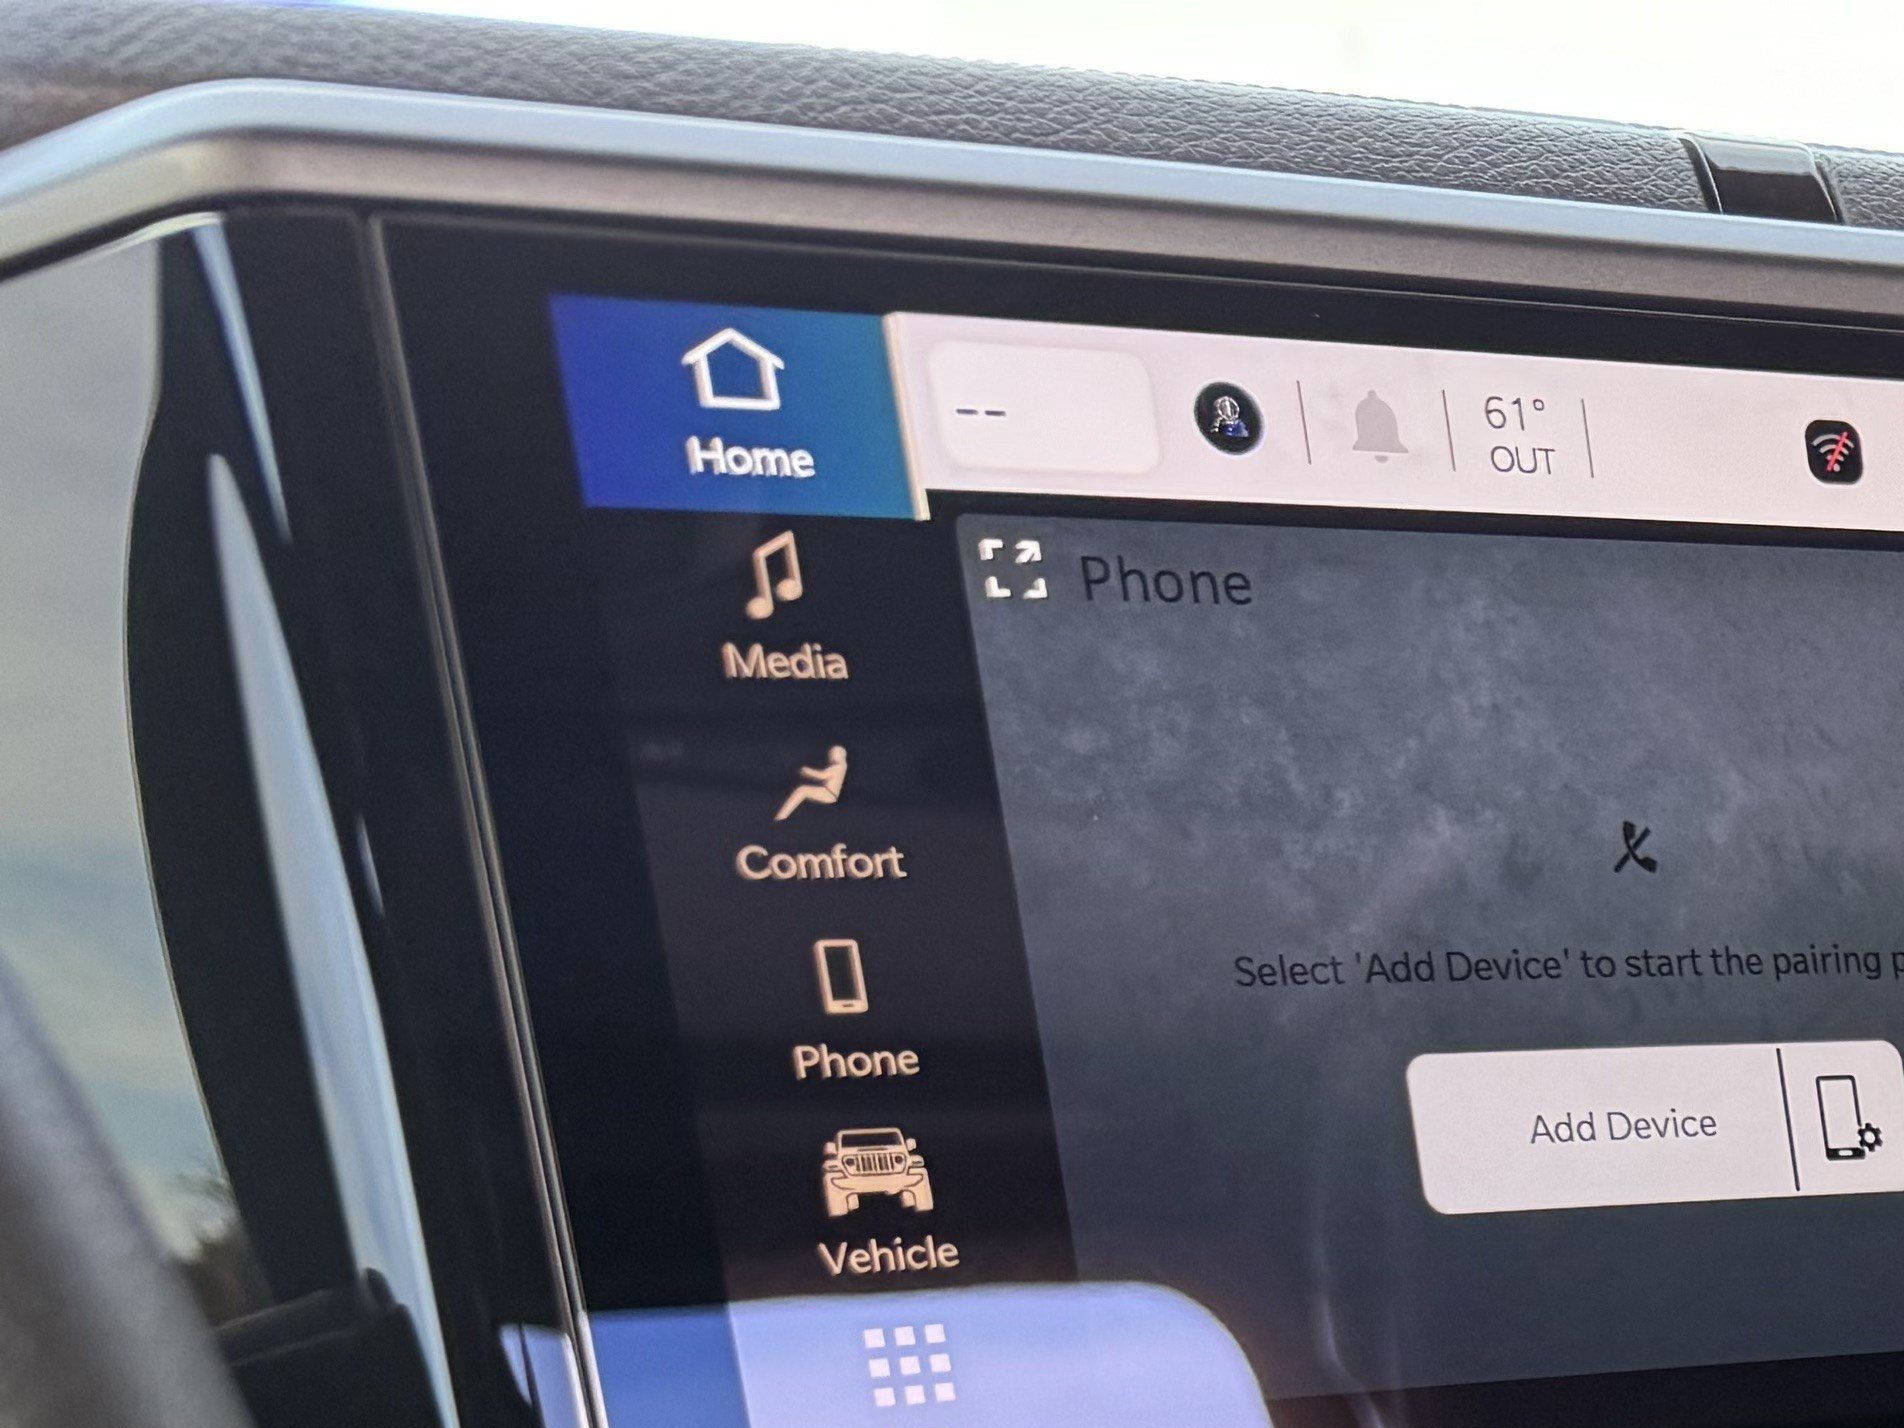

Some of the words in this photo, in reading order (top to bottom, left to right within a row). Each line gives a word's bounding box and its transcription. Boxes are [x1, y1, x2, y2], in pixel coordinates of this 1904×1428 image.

[1484, 395, 1546, 432] 61°
[686, 435, 816, 481] Home
[1490, 445, 1556, 475] OUT
[1081, 555, 1253, 607] Phone
[722, 643, 849, 682] Media
[735, 843, 908, 882] Comfort
[1235, 955, 1345, 989] Select
[1355, 950, 1436, 986] 'Add
[1446, 946, 1571, 982] Device'
[1581, 952, 1618, 980] to
[1625, 948, 1704, 978] start
[1711, 946, 1765, 978] the
[1774, 943, 1883, 986] pairing
[792, 1044, 921, 1080] Phone
[1530, 1113, 1596, 1146] Add
[1608, 1108, 1719, 1143] Device
[817, 1237, 961, 1277] Vehicle
